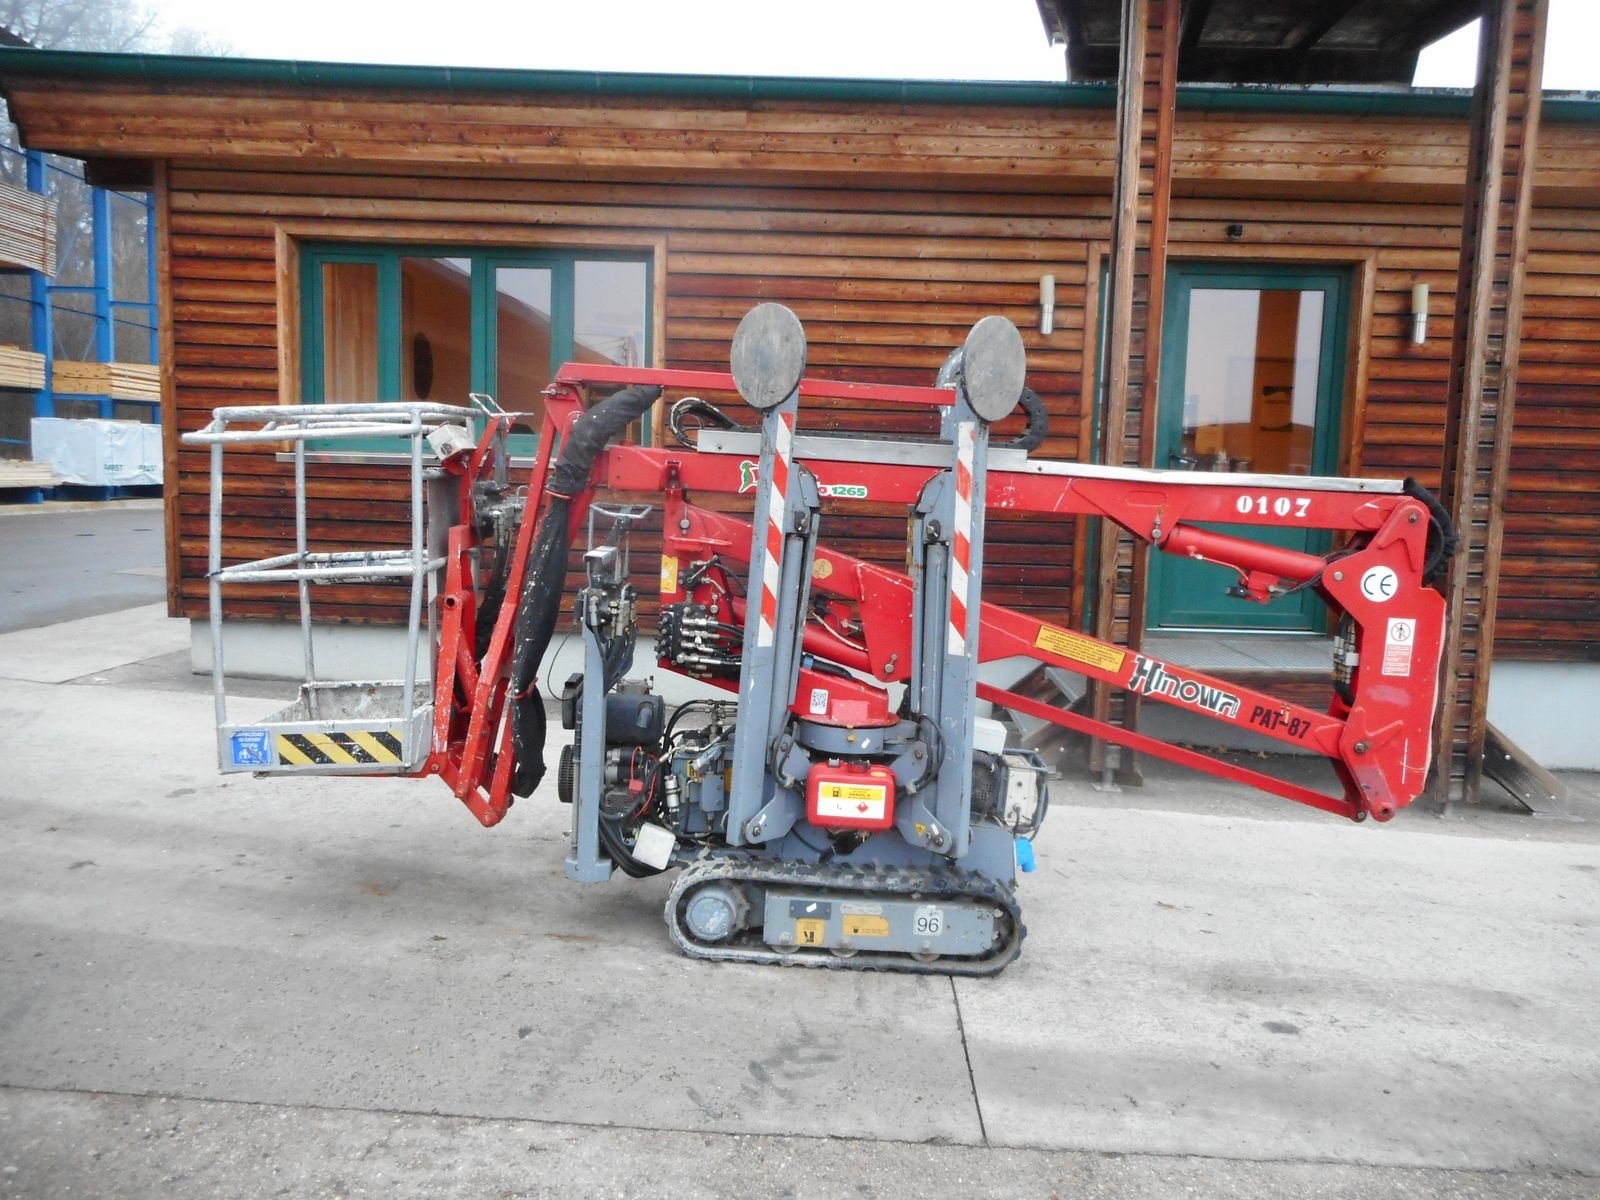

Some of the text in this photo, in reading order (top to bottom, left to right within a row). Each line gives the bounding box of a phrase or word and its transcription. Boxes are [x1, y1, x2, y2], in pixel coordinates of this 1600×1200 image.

[832, 486, 866, 497] 1265
[1236, 495, 1312, 518] 0107
[1363, 573, 1393, 596] CE
[1249, 704, 1312, 740] PAT-87
[916, 916, 940, 934] 96
